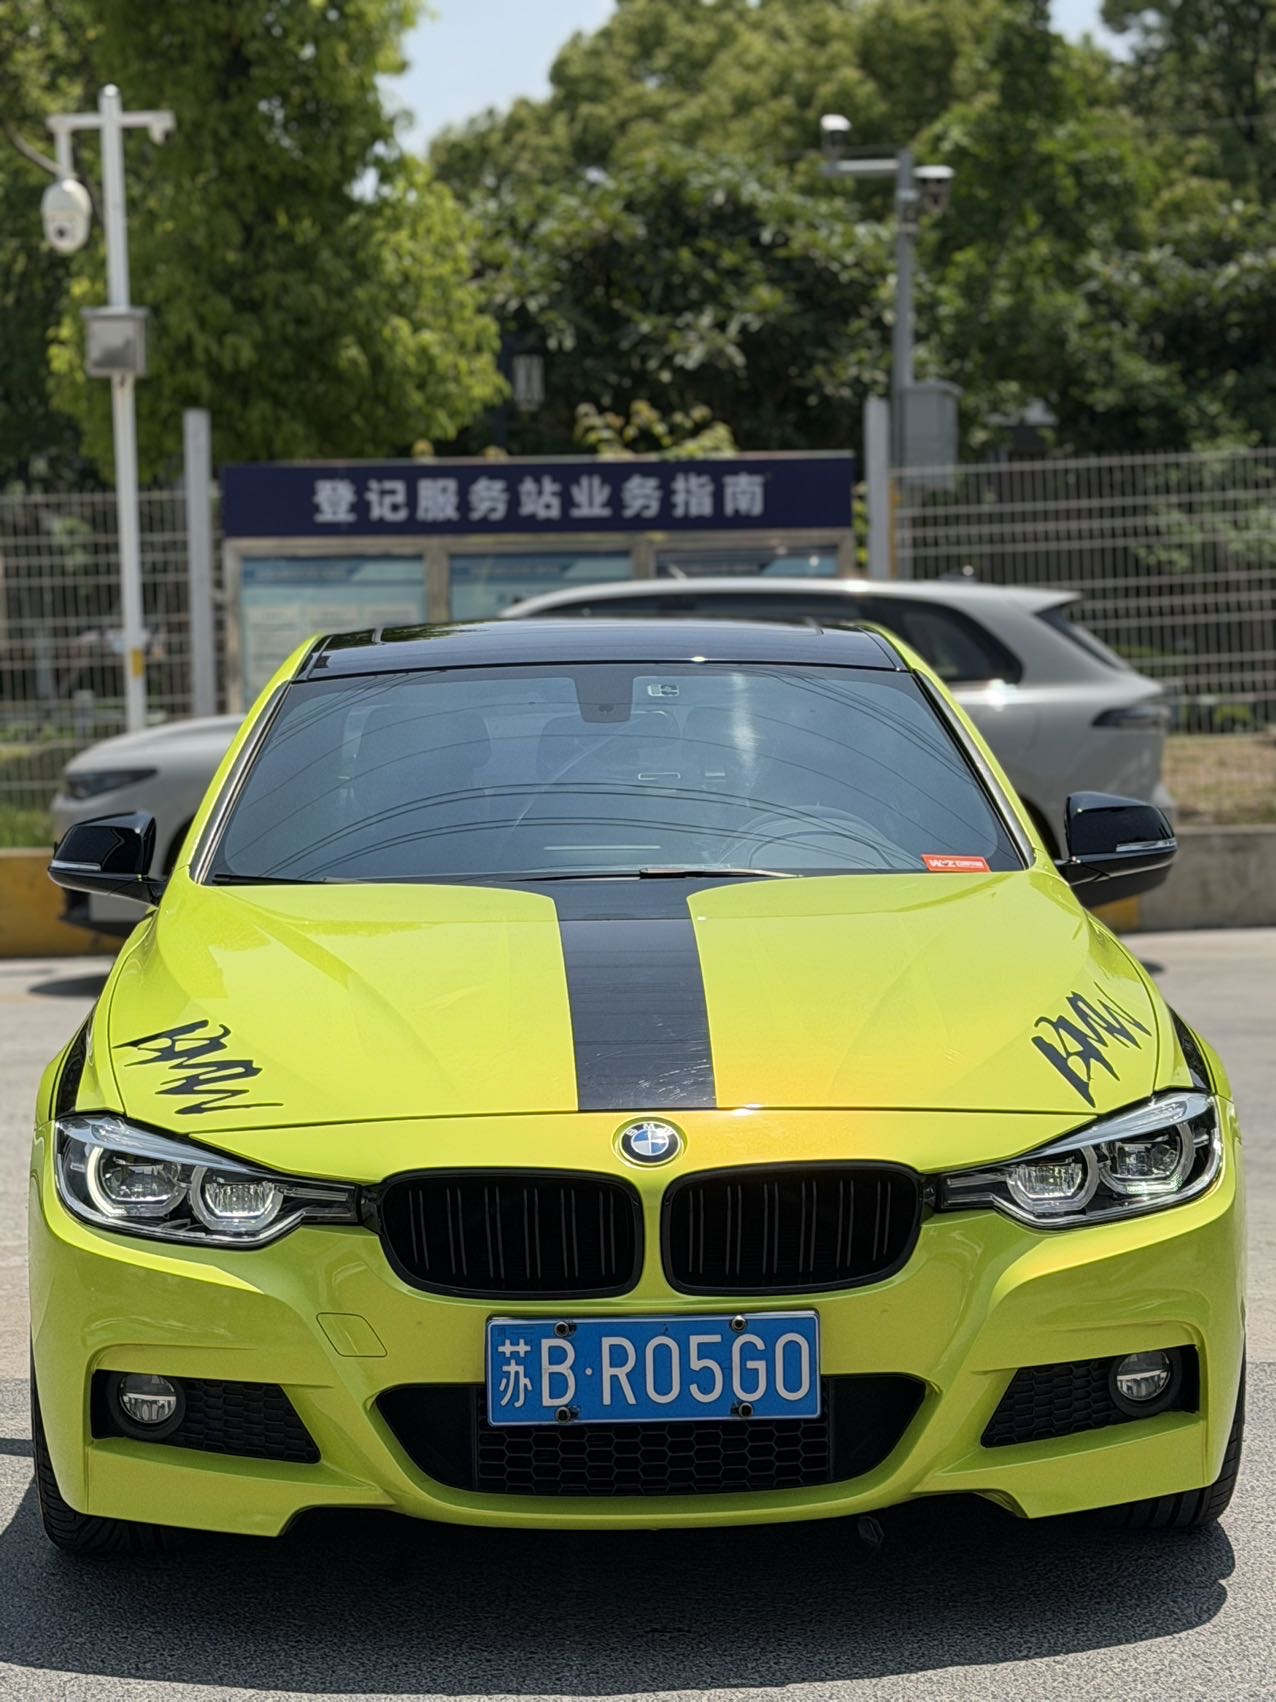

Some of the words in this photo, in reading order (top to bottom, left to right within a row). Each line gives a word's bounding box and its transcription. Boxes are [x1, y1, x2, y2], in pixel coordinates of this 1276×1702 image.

[313, 473, 765, 523] 登记服务站业务指南
